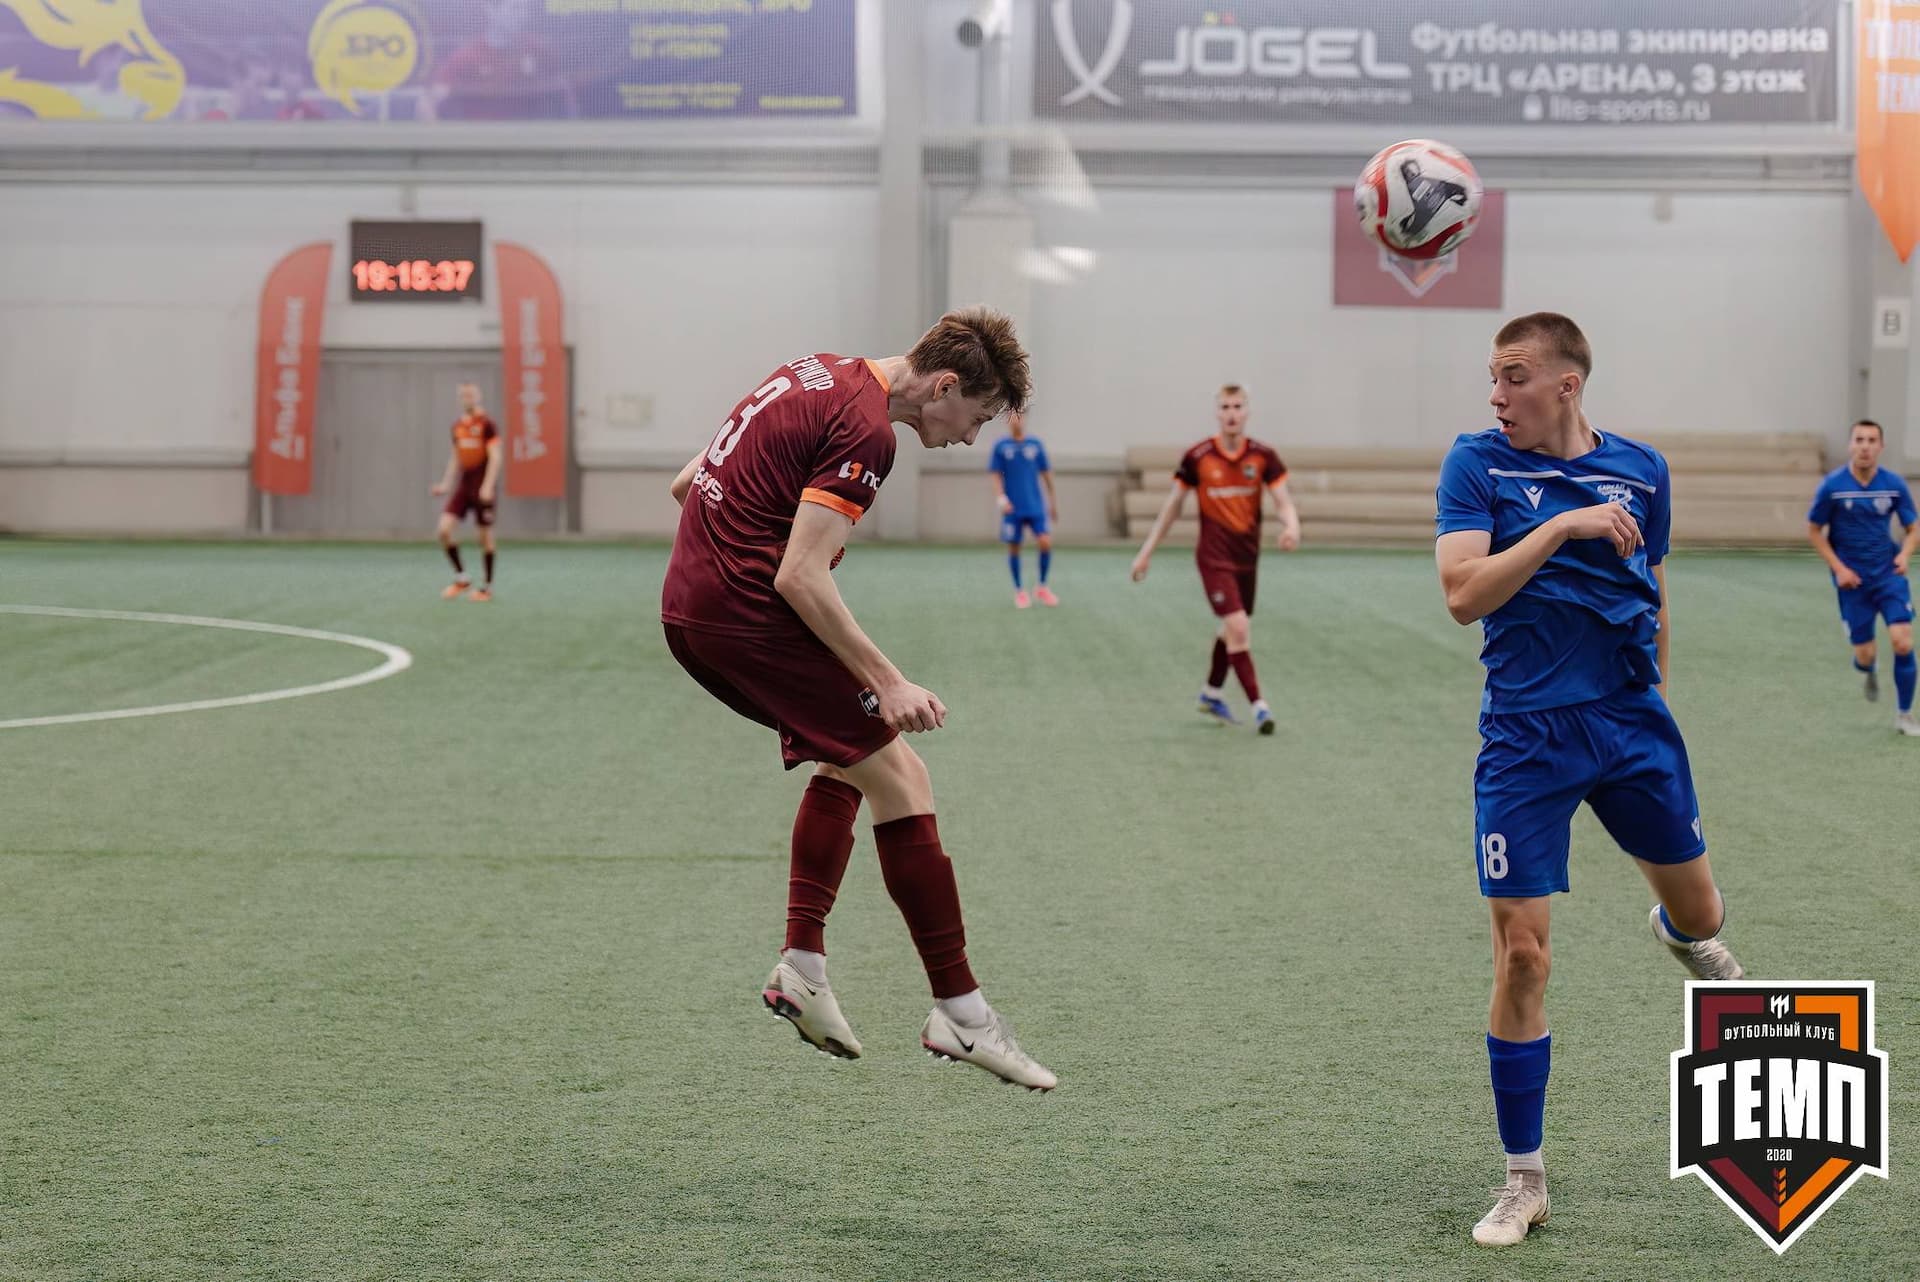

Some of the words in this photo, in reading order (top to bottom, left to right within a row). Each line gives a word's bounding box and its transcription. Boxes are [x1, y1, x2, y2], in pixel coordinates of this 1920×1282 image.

[1141, 11, 1413, 79] JÖGEL
[1410, 22, 1620, 57] Футбольная
[1628, 27, 1829, 58] экипировка
[1426, 63, 1502, 96] ТРЦ
[1508, 64, 1685, 96] «АРЕНА»,
[1692, 65, 1716, 93] 3
[1722, 69, 1807, 94] этаж
[707, 375, 792, 467] 3
[1481, 833, 1509, 880] 18
